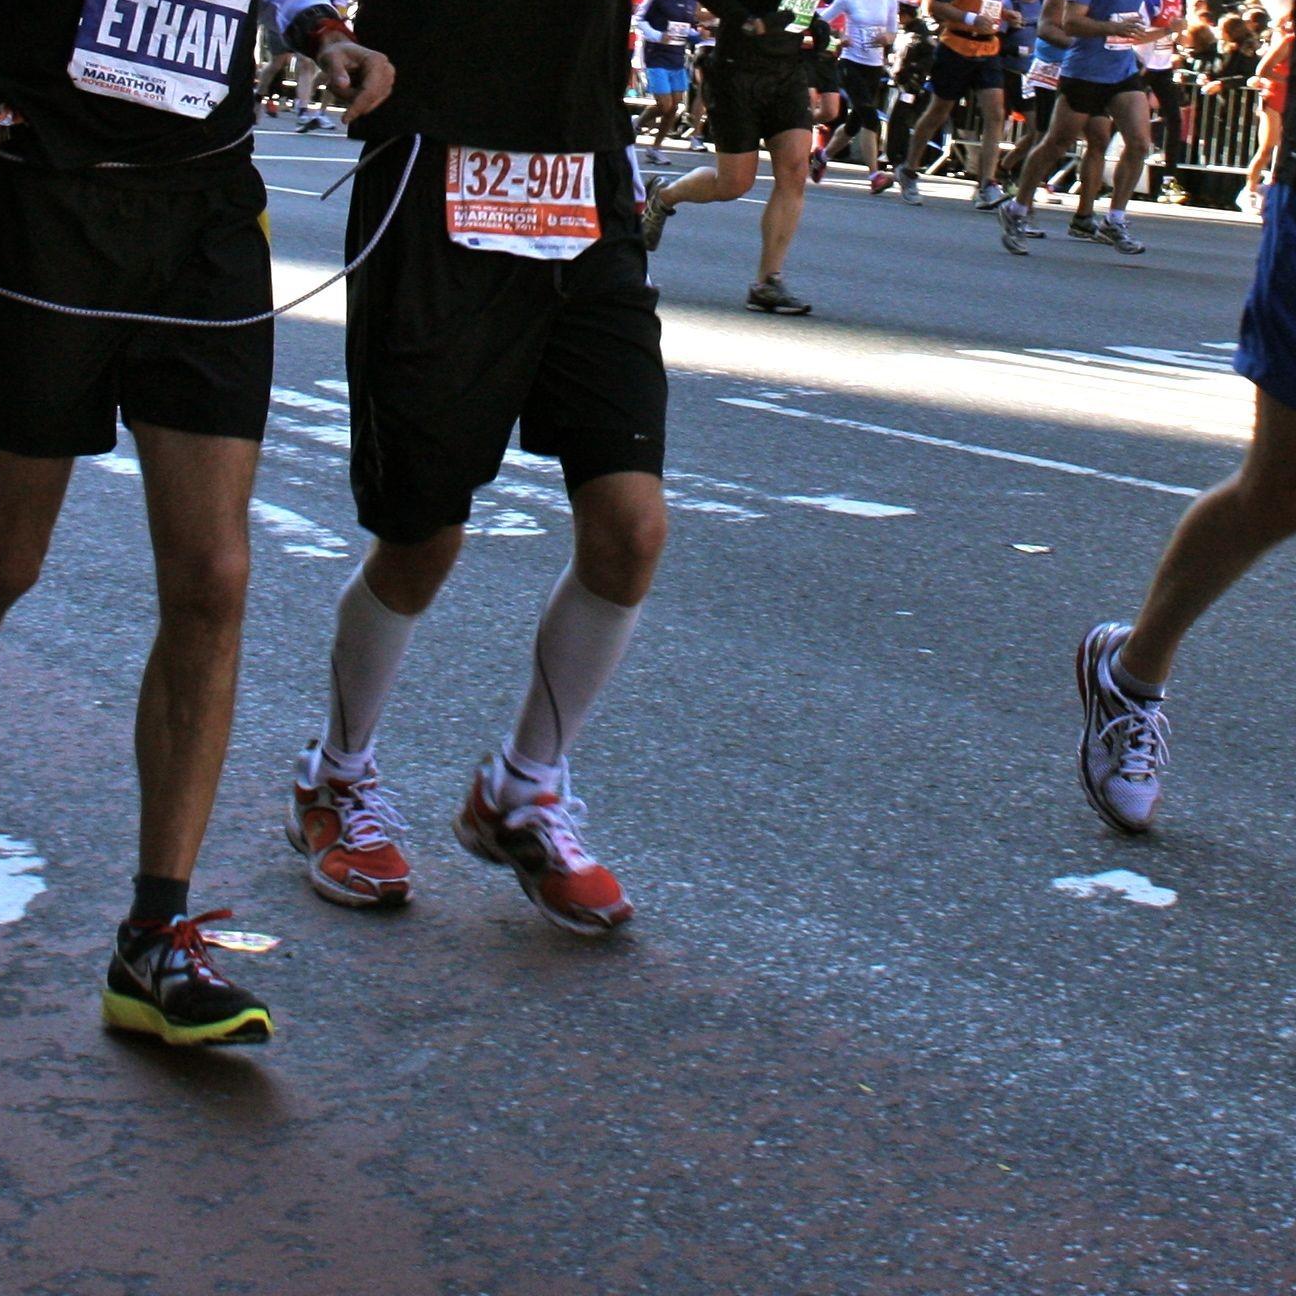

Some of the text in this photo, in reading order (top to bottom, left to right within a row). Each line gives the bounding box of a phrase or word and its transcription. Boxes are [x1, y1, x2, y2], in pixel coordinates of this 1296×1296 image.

[81, 77, 133, 93] NOVEMBER
[144, 92, 164, 101] 2011
[83, 67, 167, 95] MARATHON
[151, 76, 167, 85] CITY
[466, 150, 585, 200] 32-907
[454, 211, 537, 224] MARATHON
